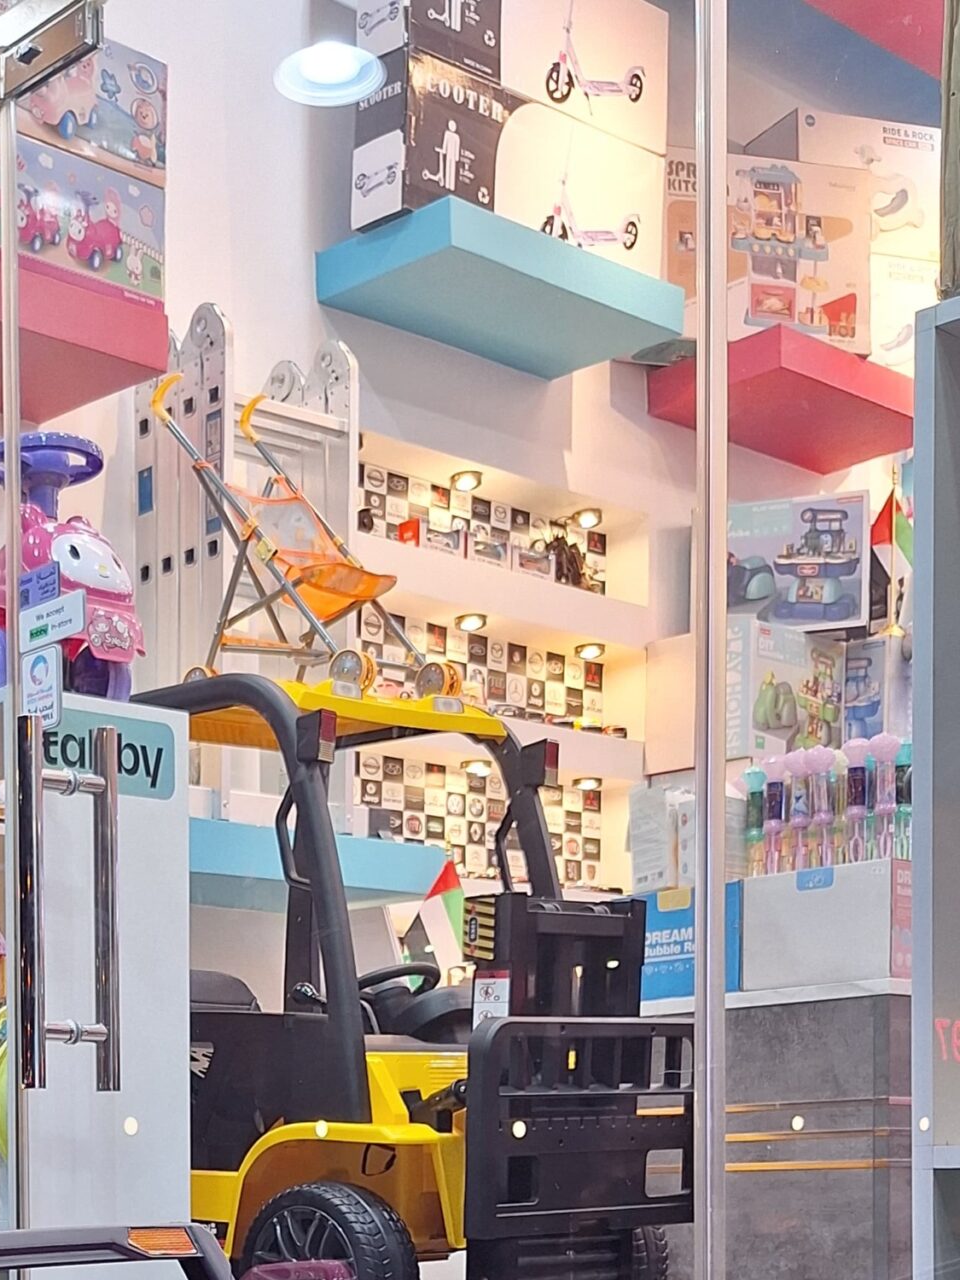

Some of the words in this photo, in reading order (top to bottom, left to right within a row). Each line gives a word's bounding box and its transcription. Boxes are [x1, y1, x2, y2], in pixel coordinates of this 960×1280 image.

[413, 70, 504, 123] COOTER
[882, 126, 901, 137] RIDE
[903, 128, 911, 138] &
[42, 729, 164, 789] taby
